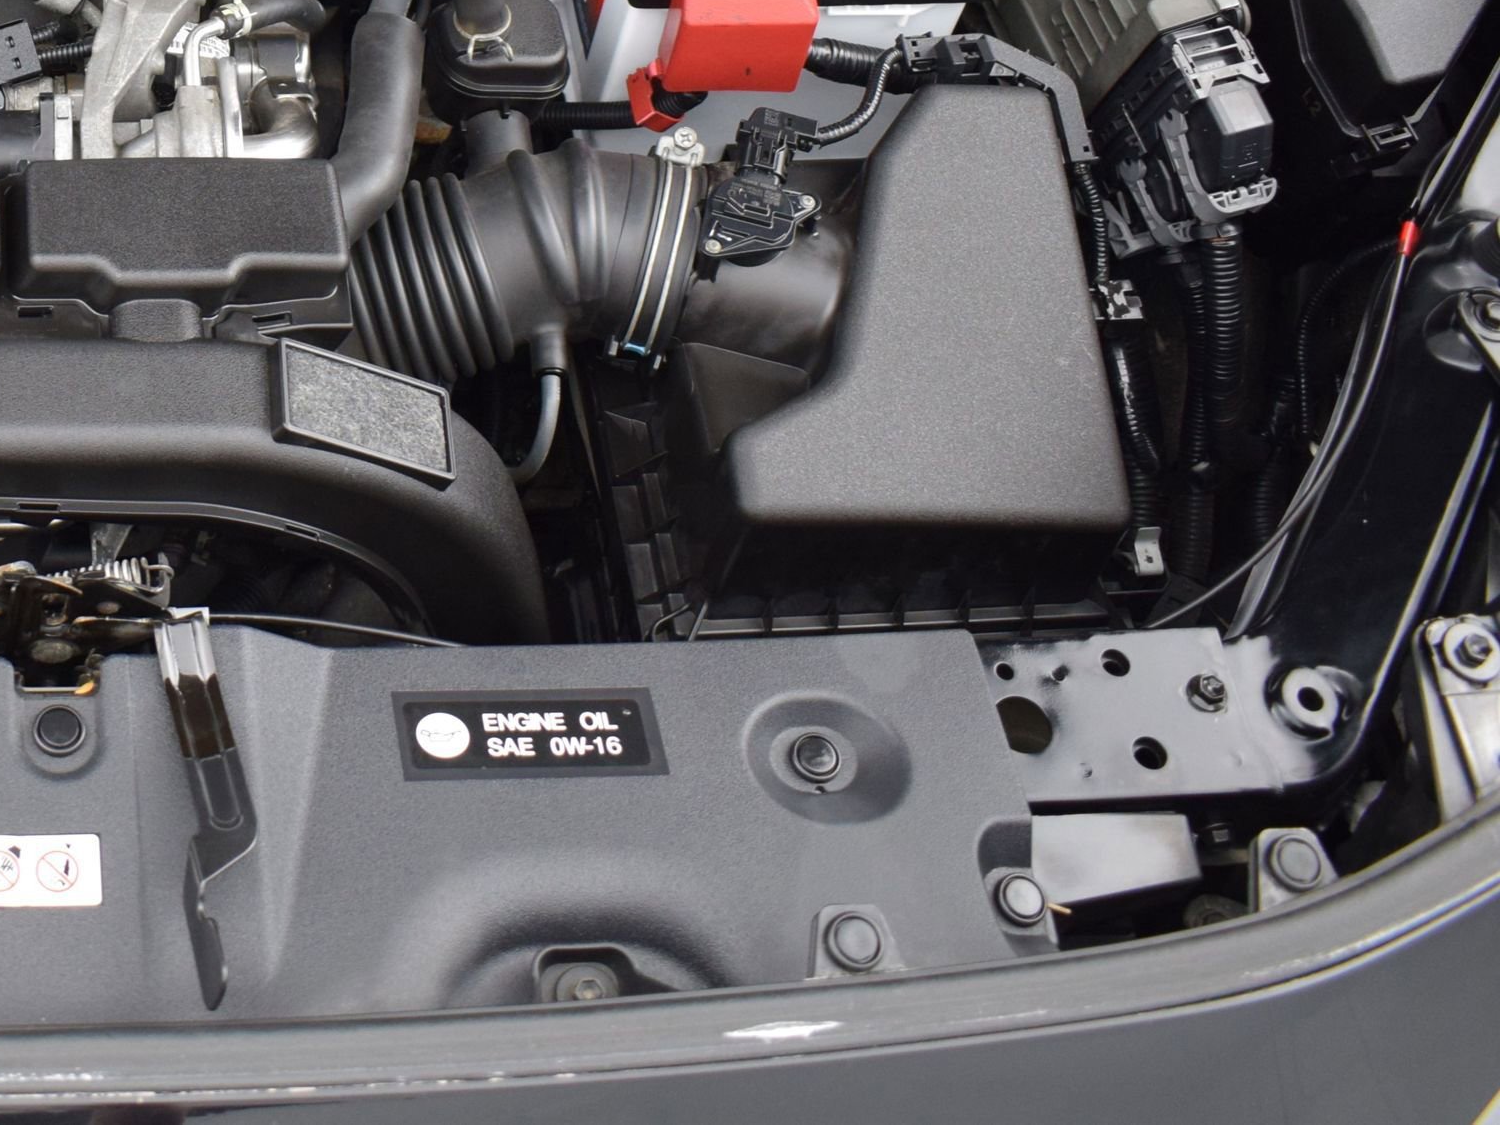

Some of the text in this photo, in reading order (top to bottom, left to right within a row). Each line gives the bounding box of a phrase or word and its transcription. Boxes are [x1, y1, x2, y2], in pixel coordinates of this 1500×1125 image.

[481, 711, 619, 732] ENGINE OIL
[486, 735, 623, 757] SAE 0W-16
